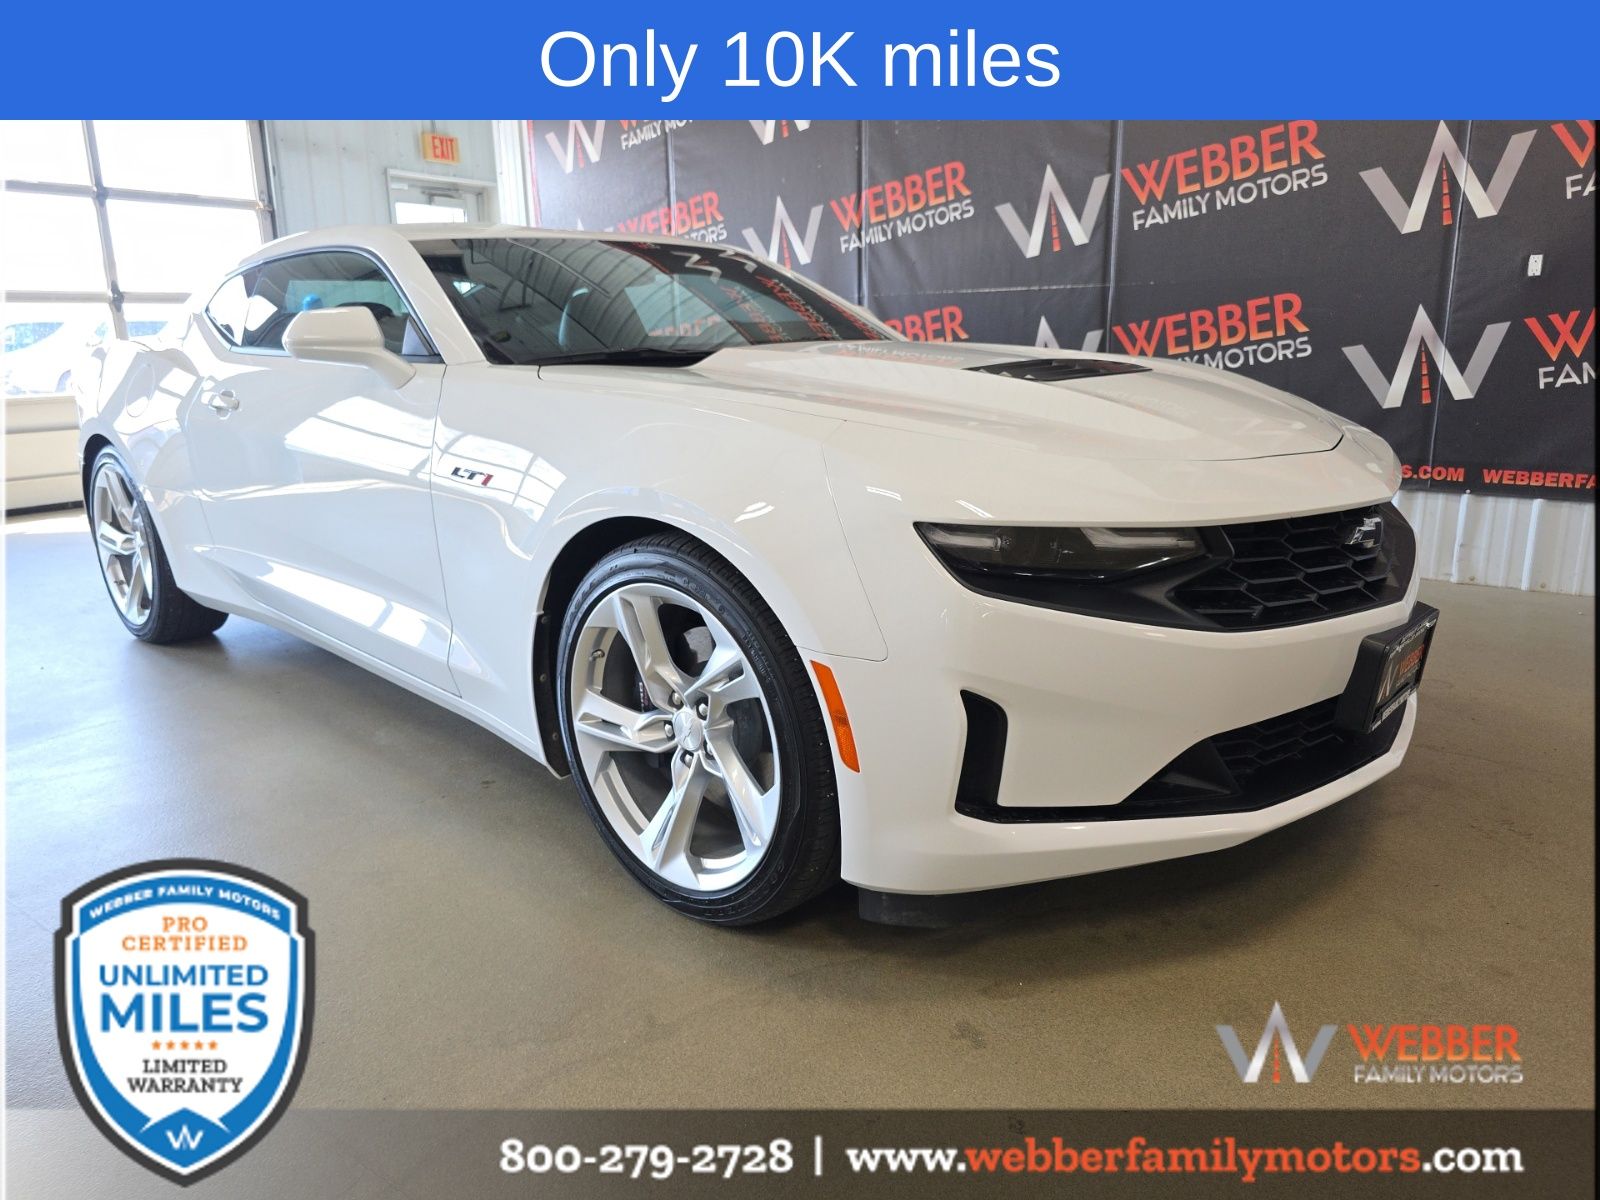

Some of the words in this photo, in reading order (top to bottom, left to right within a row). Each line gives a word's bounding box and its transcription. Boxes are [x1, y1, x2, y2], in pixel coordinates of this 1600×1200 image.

[431, 135, 456, 161] EXIT
[620, 120, 661, 150] FAMILY
[1121, 119, 1326, 205] WEBBER
[830, 161, 973, 232] WEBBER
[1132, 193, 1212, 231] FAMILY
[1215, 163, 1329, 211] MOTORS
[840, 222, 894, 254] FAMILY
[900, 199, 975, 234] MOTORS
[1112, 292, 1310, 358] WEBBER
[1204, 336, 1313, 370] MOTORS
[451, 466, 494, 487] LT1
